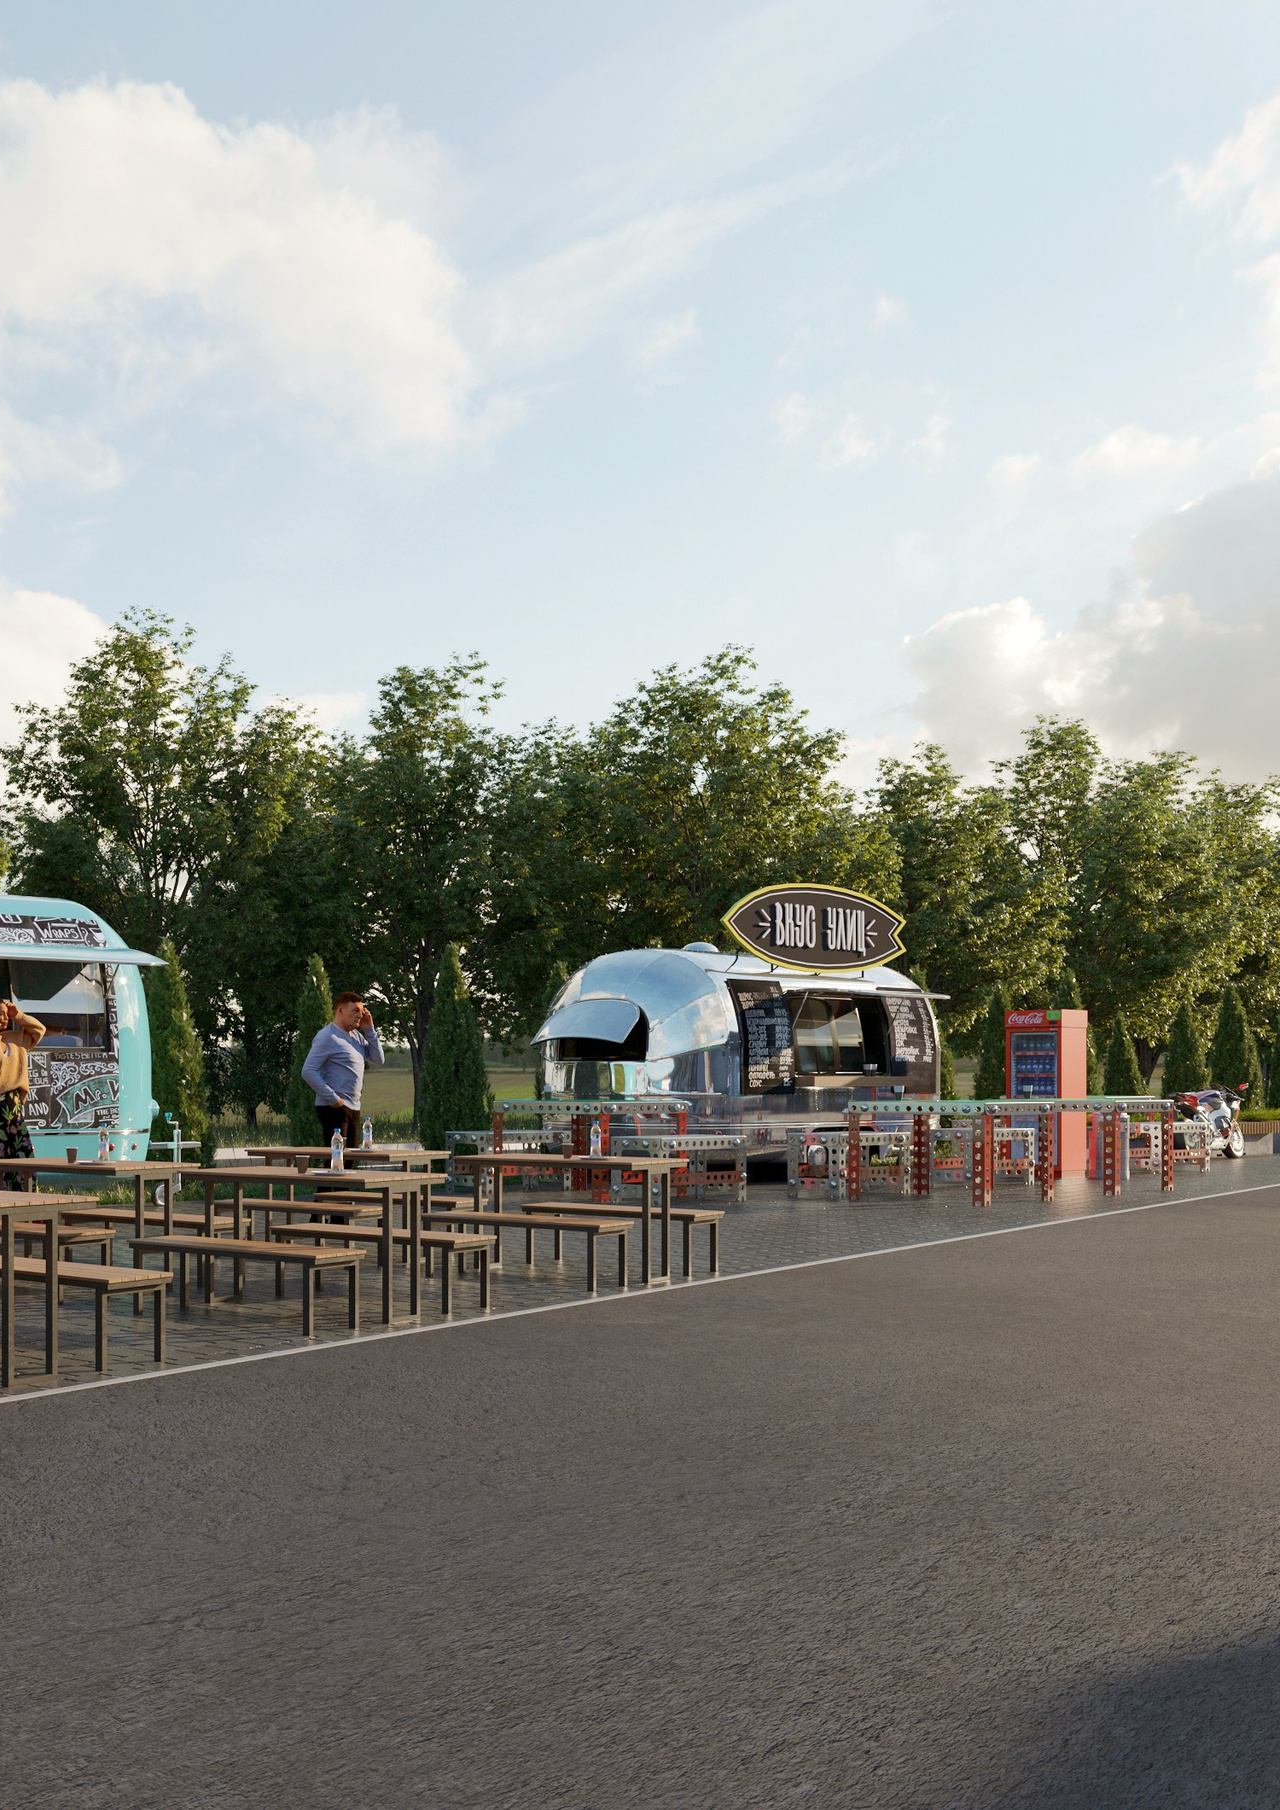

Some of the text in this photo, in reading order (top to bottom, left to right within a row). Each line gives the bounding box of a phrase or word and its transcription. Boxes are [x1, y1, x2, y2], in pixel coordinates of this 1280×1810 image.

[33, 921, 79, 939] WRAPS
[775, 902, 867, 957] ВКУС УЛИЦ
[1008, 1012, 1045, 1025] Coca-Cola
[29, 1102, 49, 1116] AND
[74, 1086, 108, 1114] Mr.
